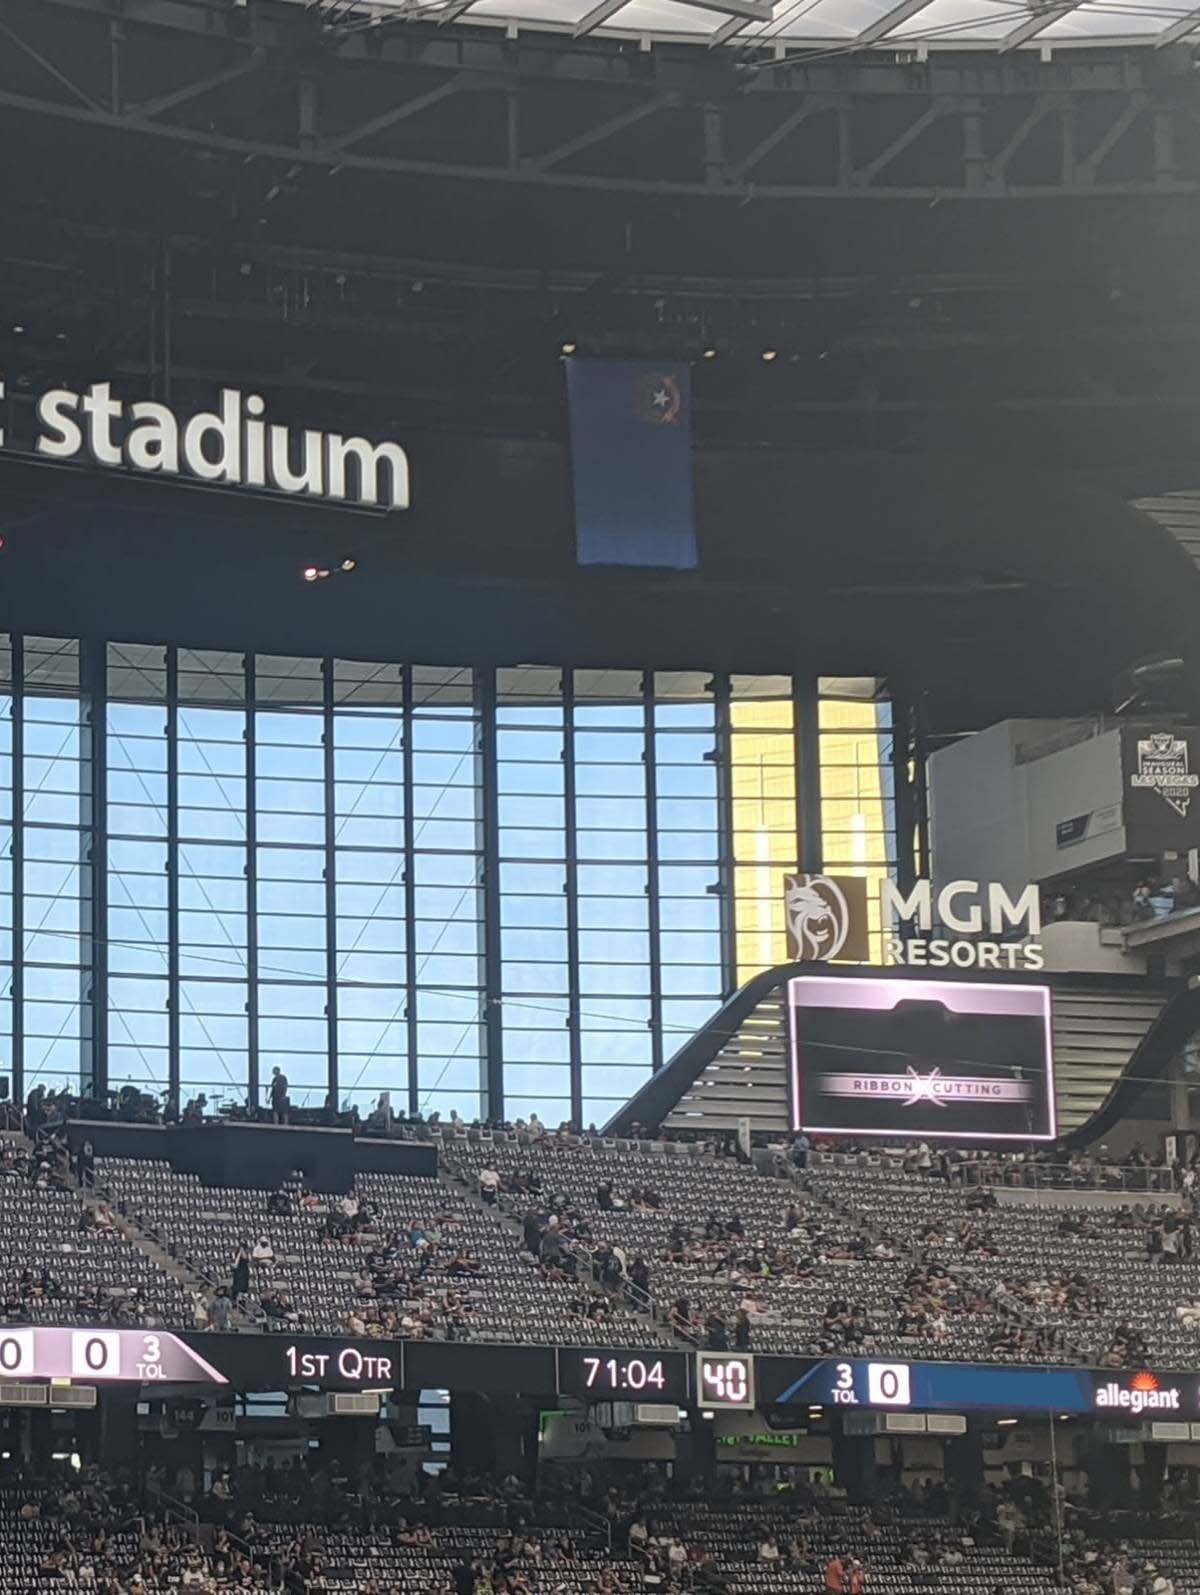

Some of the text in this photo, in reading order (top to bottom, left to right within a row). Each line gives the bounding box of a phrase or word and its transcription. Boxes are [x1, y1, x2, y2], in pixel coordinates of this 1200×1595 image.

[38, 383, 410, 508] stadium
[1143, 767, 1185, 775] SEASON
[881, 878, 1041, 935] MGM
[883, 939, 1044, 969] RESORTS
[853, 1080, 1002, 1095] RIBBON CUTTING
[0, 1337, 22, 1370] 0
[85, 1337, 108, 1370] 0
[142, 1335, 161, 1362] 3
[286, 1346, 392, 1379] 1ST QTR
[136, 1363, 167, 1378] TOL
[584, 1358, 665, 1389] 71:04
[703, 1361, 746, 1400] 40
[836, 1363, 853, 1389] 3
[880, 1369, 898, 1399] 0
[831, 1389, 859, 1403] TOL
[1096, 1383, 1180, 1413] allegiant
